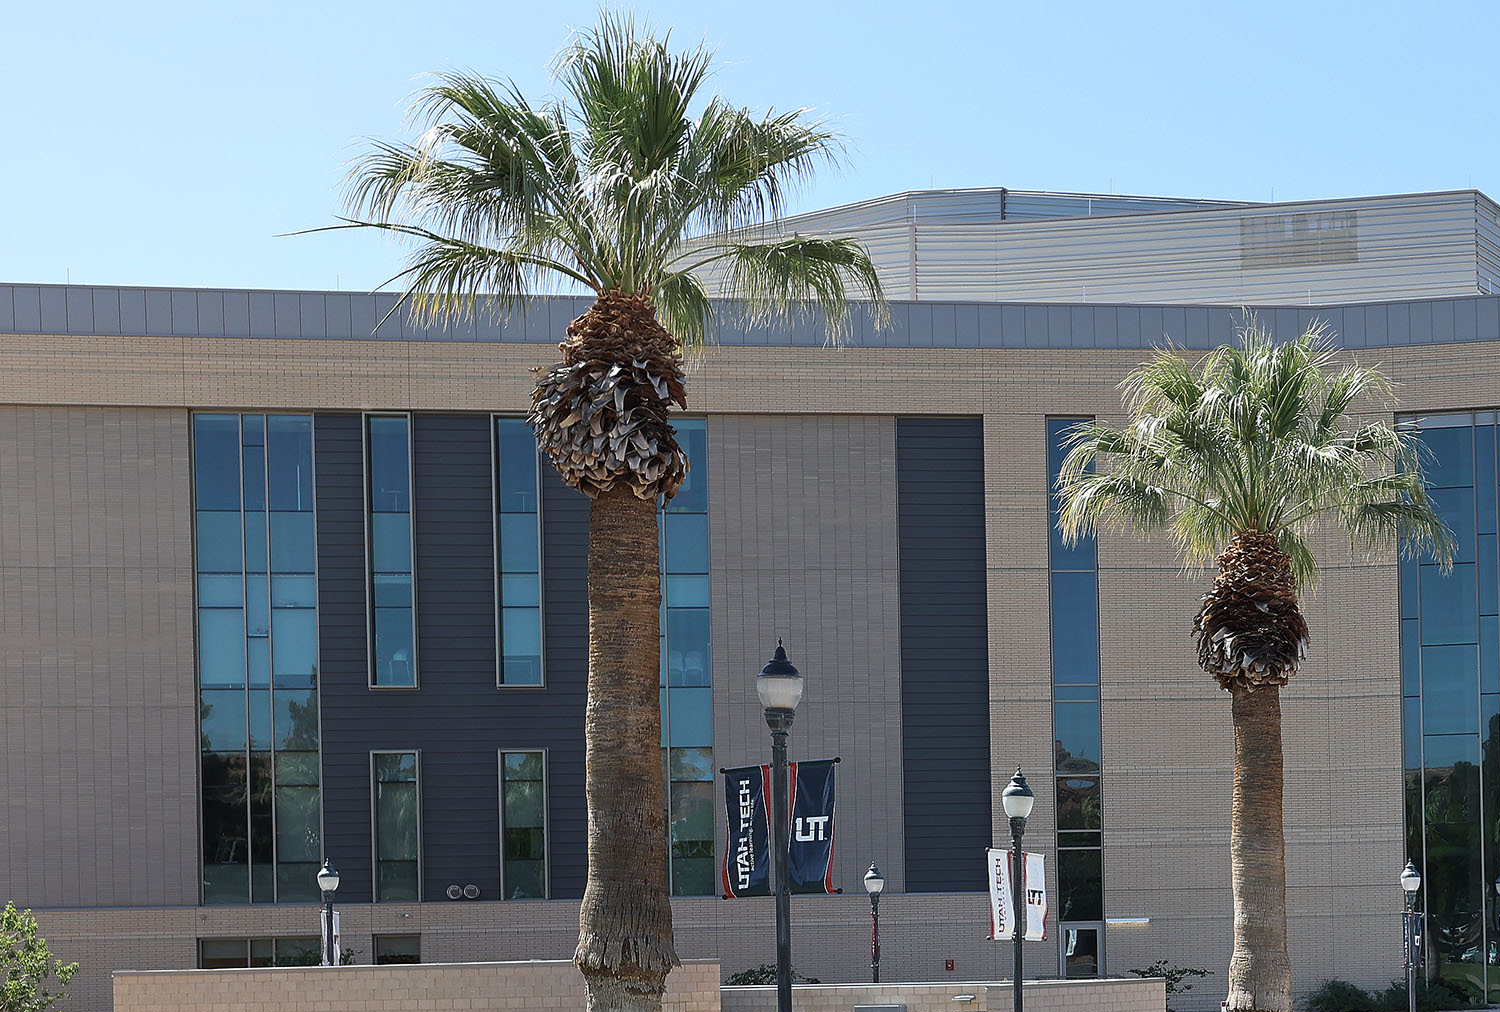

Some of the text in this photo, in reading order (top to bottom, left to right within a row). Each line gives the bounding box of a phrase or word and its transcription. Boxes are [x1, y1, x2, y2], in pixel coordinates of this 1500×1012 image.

[737, 780, 750, 890] UTAH TECH
[795, 816, 829, 842] UT
[997, 898, 1005, 933] UTAH
